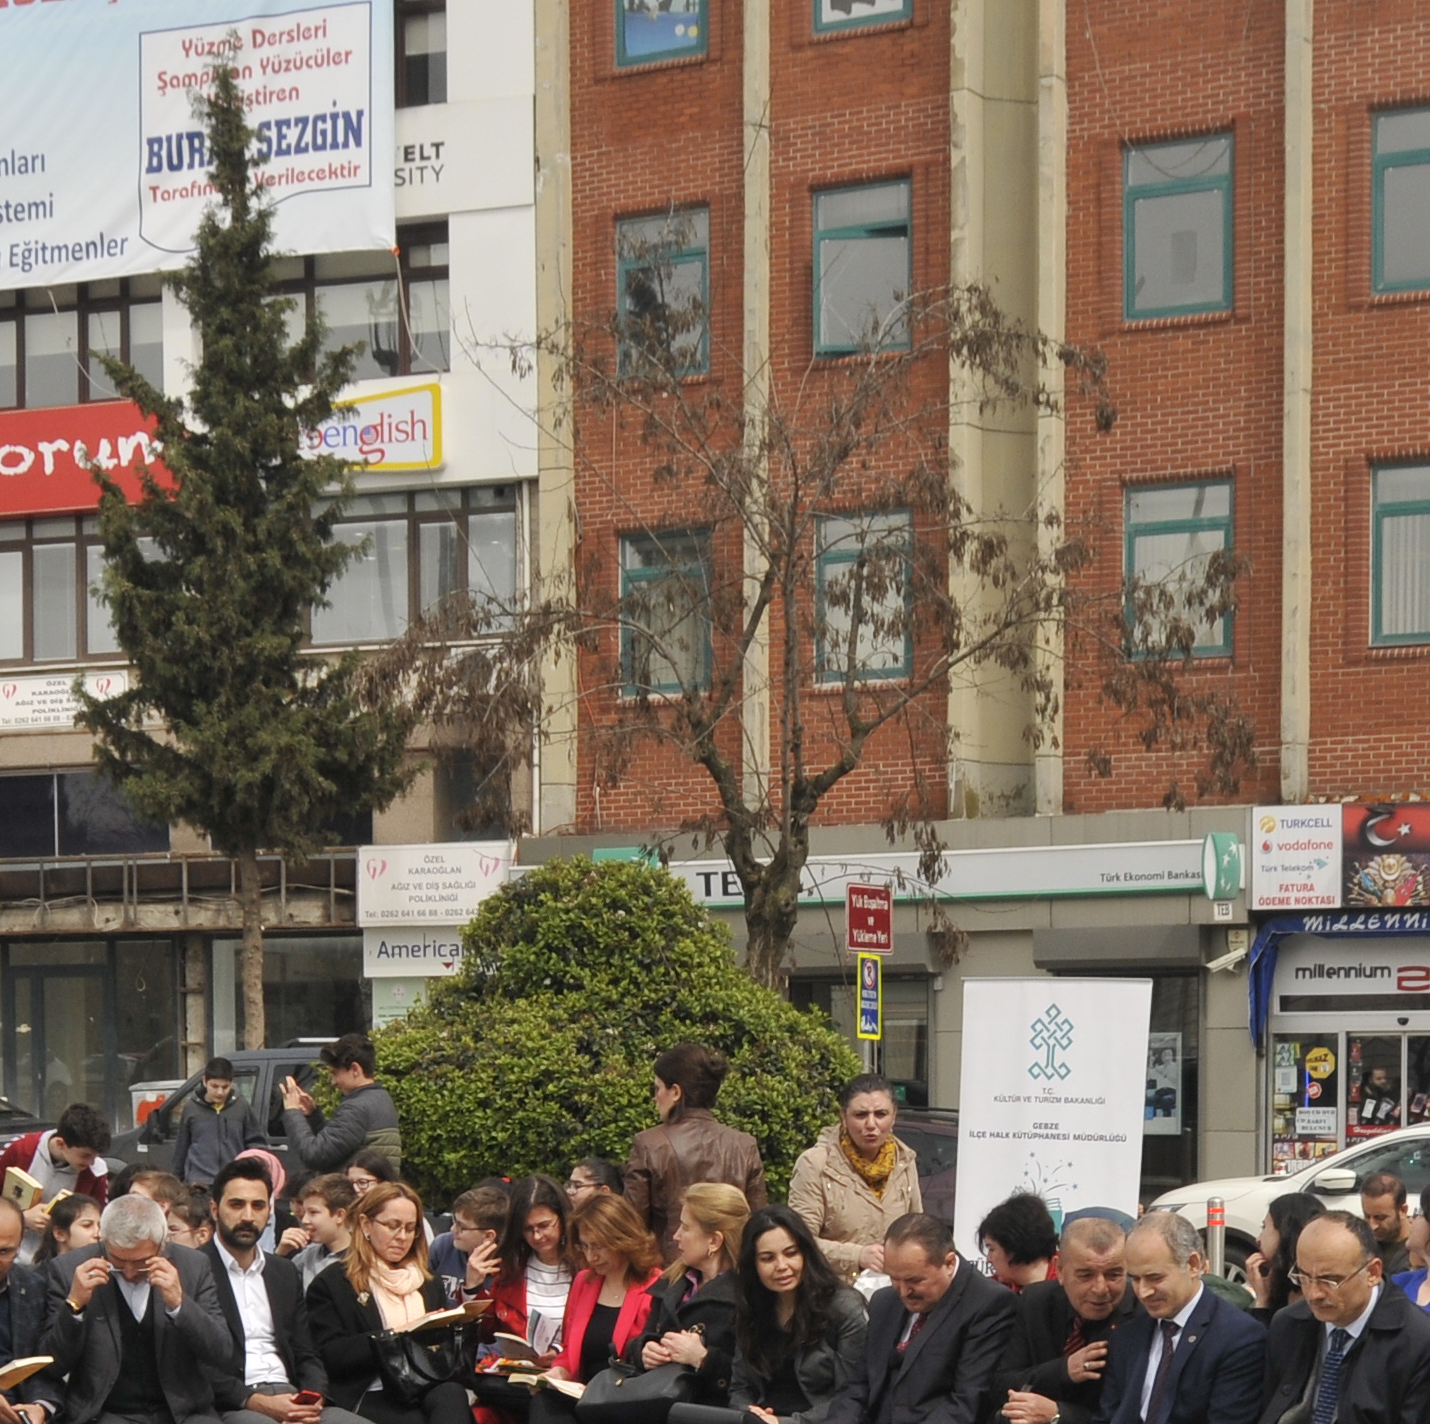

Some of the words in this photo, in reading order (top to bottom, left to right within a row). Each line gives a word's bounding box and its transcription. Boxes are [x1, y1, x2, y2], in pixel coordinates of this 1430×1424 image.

[181, 35, 244, 58] Yüzme
[252, 18, 327, 49] Dersleri
[157, 63, 253, 97] Şampon
[260, 47, 353, 76] Yüzücüler
[145, 130, 216, 174] BUR
[255, 99, 364, 162] SEZGİN
[396, 141, 445, 163] ELT
[149, 180, 223, 204] Tarafın
[254, 160, 361, 189] Verilecektir
[9, 231, 129, 273] Eğitmenler
[1280, 818, 1333, 829] TURKCELL
[1277, 840, 1334, 851] vodafone
[423, 855, 446, 864] ÖZEL
[408, 865, 462, 875] KARAOĞLAN
[1261, 865, 1278, 873] Türk
[1280, 865, 1314, 873] Telekom
[1100, 872, 1121, 883] Türk
[1123, 870, 1165, 882] Ekonomi
[1167, 869, 1202, 880] Bankas
[390, 881, 411, 891] AĞIZ
[412, 882, 424, 891] VE
[425, 881, 440, 891] DİŞ
[442, 879, 476, 890] SAĞLIĞI
[695, 871, 744, 898] TE
[1278, 883, 1315, 893] FATURA
[408, 893, 459, 903] POLİKLİNİĞİ
[1258, 896, 1291, 907] ÖDEME
[1294, 895, 1336, 906] NOKTASI
[364, 910, 379, 919] Tel:
[381, 909, 399, 919] 0262
[401, 909, 415, 918] 641
[417, 909, 427, 918] 66
[428, 909, 438, 918] 88
[445, 908, 464, 917] 0262
[376, 938, 466, 960] America
[1295, 962, 1392, 980] millennium
[993, 1094, 1021, 1104] KÜLTÜR
[1022, 1095, 1032, 1104] VE
[1033, 1095, 1062, 1104] TURİZM
[1063, 1095, 1106, 1105] BAKANLIĞI
[1032, 1122, 1060, 1131] GEBZE
[969, 1129, 987, 1139] İLÇE
[989, 1130, 1010, 1139] HALK
[1012, 1131, 1071, 1141] KÜTÜPHANESİ
[1072, 1132, 1128, 1143] MÜDÜRLÜĞÜ
